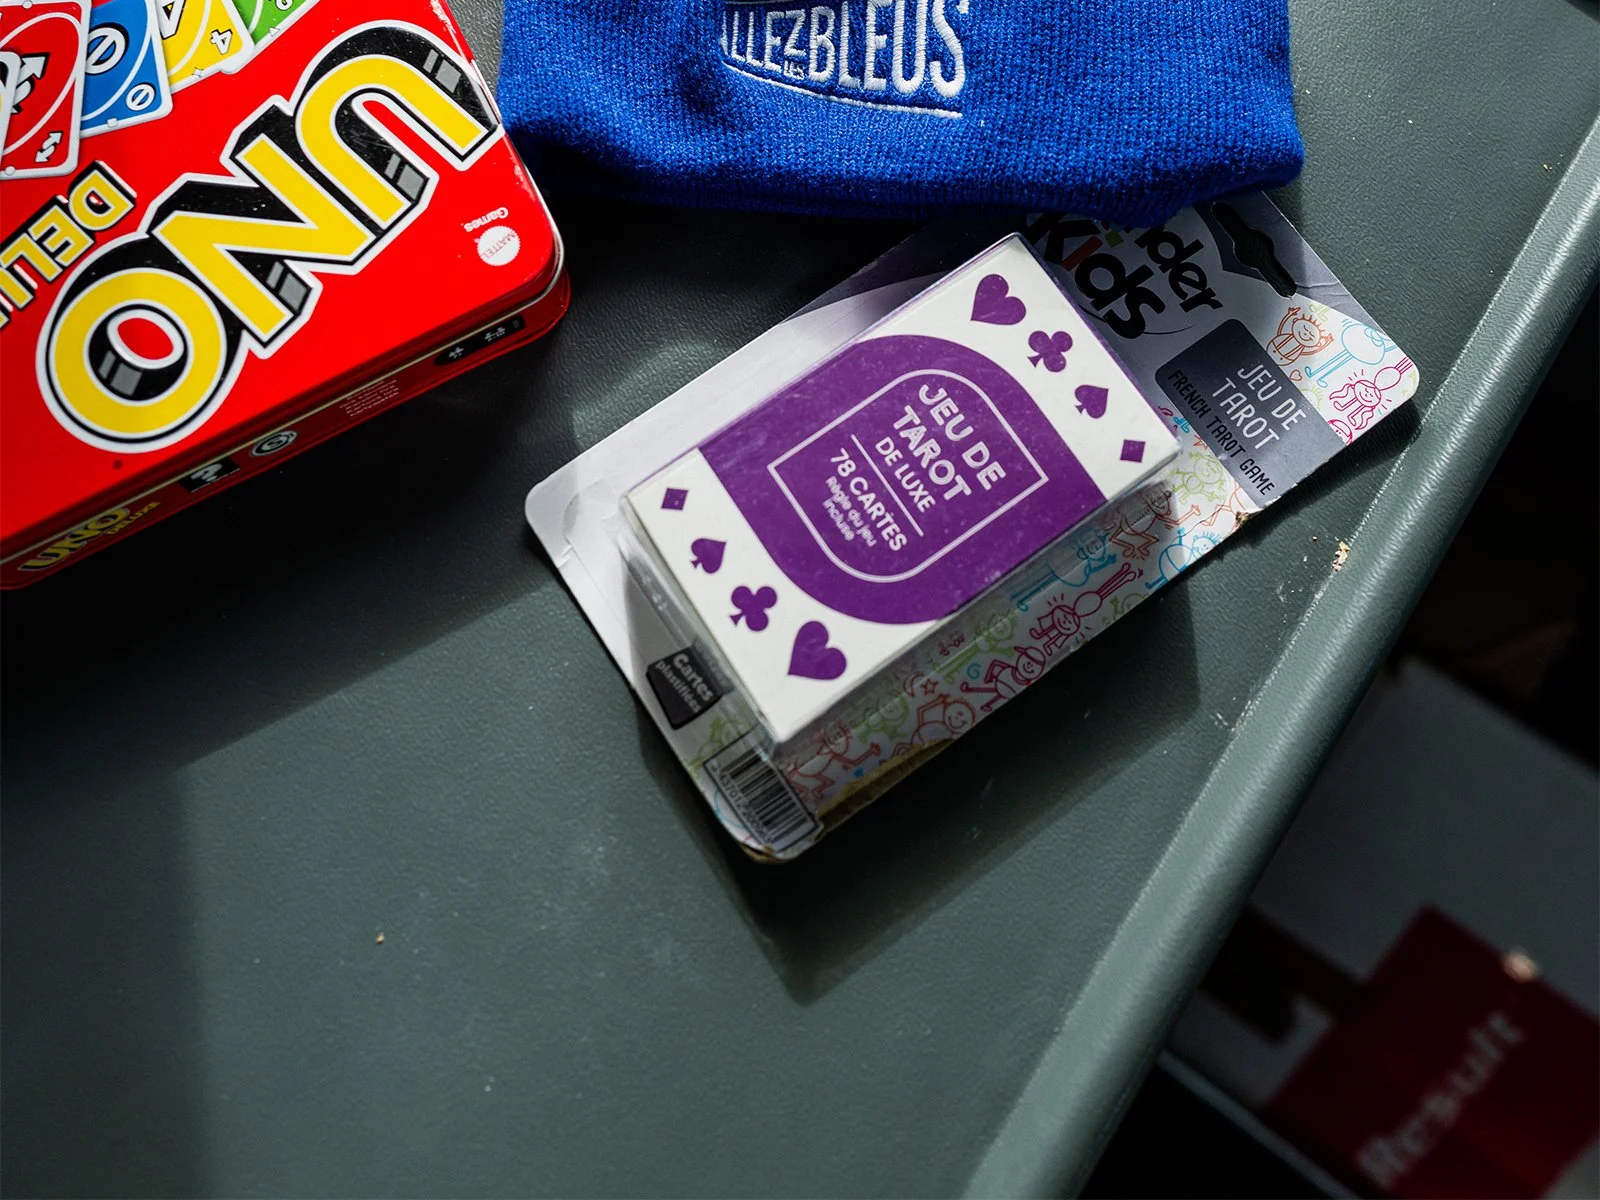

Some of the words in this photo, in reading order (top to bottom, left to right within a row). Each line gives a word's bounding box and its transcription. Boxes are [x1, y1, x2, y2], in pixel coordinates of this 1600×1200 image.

[210, 28, 233, 55] 4
[36, 20, 505, 453] UNO
[463, 206, 509, 233] Games
[481, 231, 516, 258] MATTEL
[1134, 224, 1224, 313] der
[1212, 377, 1280, 450] TAROT
[1237, 364, 1282, 402] JEU
[1271, 398, 1307, 431] DE
[893, 405, 972, 501] TAROT
[918, 384, 974, 442] JEU
[961, 441, 1007, 491] DE
[1167, 369, 1212, 419] FRENCH
[1206, 415, 1246, 458] TAROT
[1239, 458, 1275, 496] GAME
[830, 448, 857, 477] 78
[849, 476, 908, 551] CARTES
[875, 436, 903, 467] DE
[894, 463, 936, 513] LUXE
[17, 507, 130, 571] UNO
[822, 498, 855, 541] incluse
[847, 508, 864, 528] du
[856, 523, 878, 548] jeu
[656, 661, 702, 714] plastifiées
[672, 653, 714, 703] Cartes
